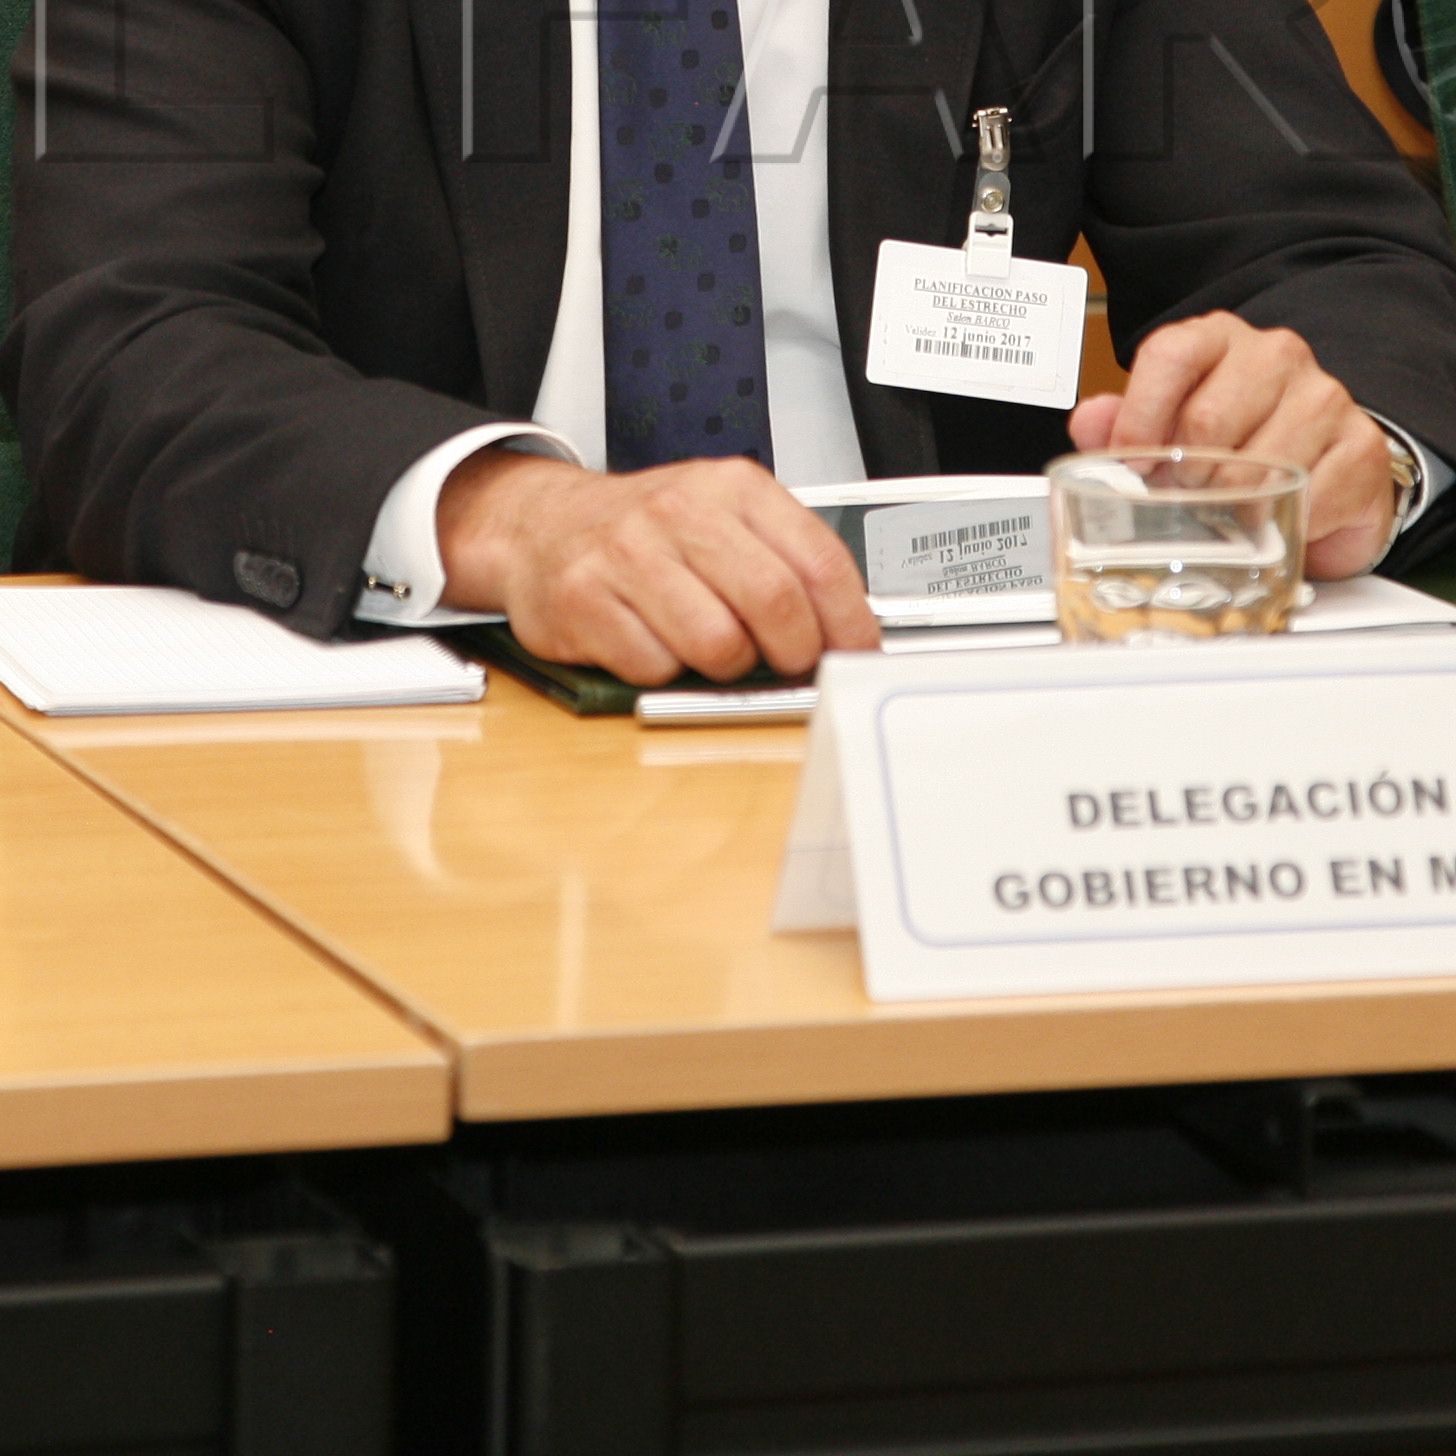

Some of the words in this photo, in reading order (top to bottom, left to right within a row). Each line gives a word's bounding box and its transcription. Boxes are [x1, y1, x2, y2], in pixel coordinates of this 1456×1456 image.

[914, 278, 1013, 300] PLANIFICACION
[1015, 290, 1048, 305] PASO
[933, 296, 958, 309] DEL
[960, 300, 1027, 317] ESTRECHO
[943, 326, 958, 339] 12
[962, 329, 996, 345] junio
[1000, 333, 1032, 348] 2017
[1066, 771, 1449, 832] DELEGACIÓN
[992, 861, 1307, 913] GOBIERNO
[1328, 855, 1407, 899] EN
